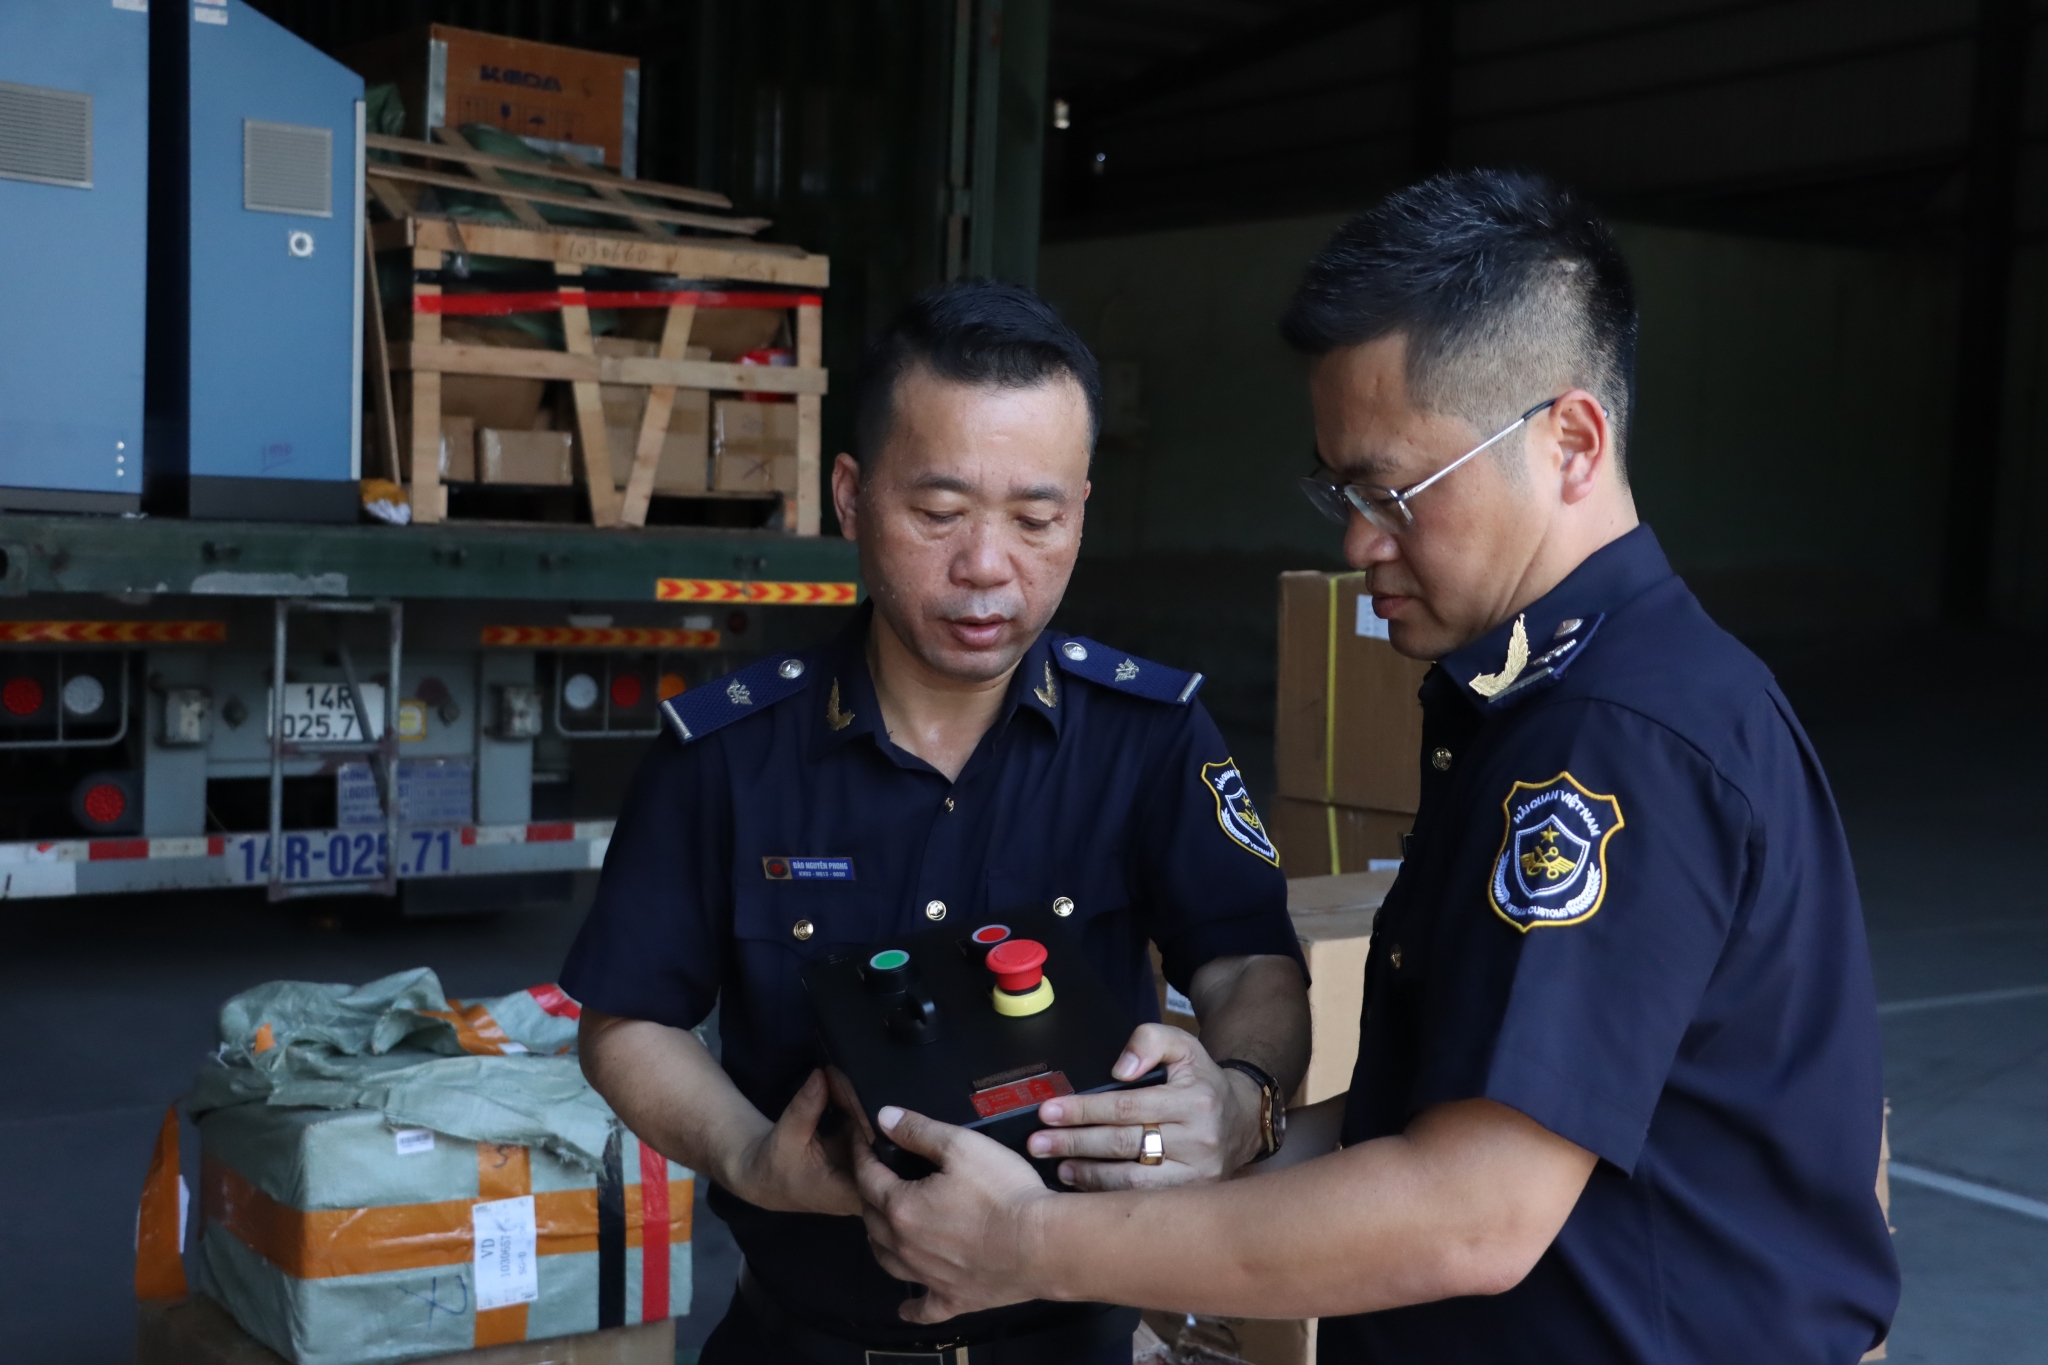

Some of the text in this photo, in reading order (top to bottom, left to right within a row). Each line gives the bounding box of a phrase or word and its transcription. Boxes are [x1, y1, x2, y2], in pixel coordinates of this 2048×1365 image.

[306, 685, 351, 711] 14R
[284, 714, 360, 739] 025.7
[1514, 804, 1531, 824] HẢI
[1529, 789, 1559, 809] QUAN
[828, 862, 848, 870] PHONG
[1527, 906, 1568, 918] CUSTOMS
[480, 1238, 495, 1259] VD
